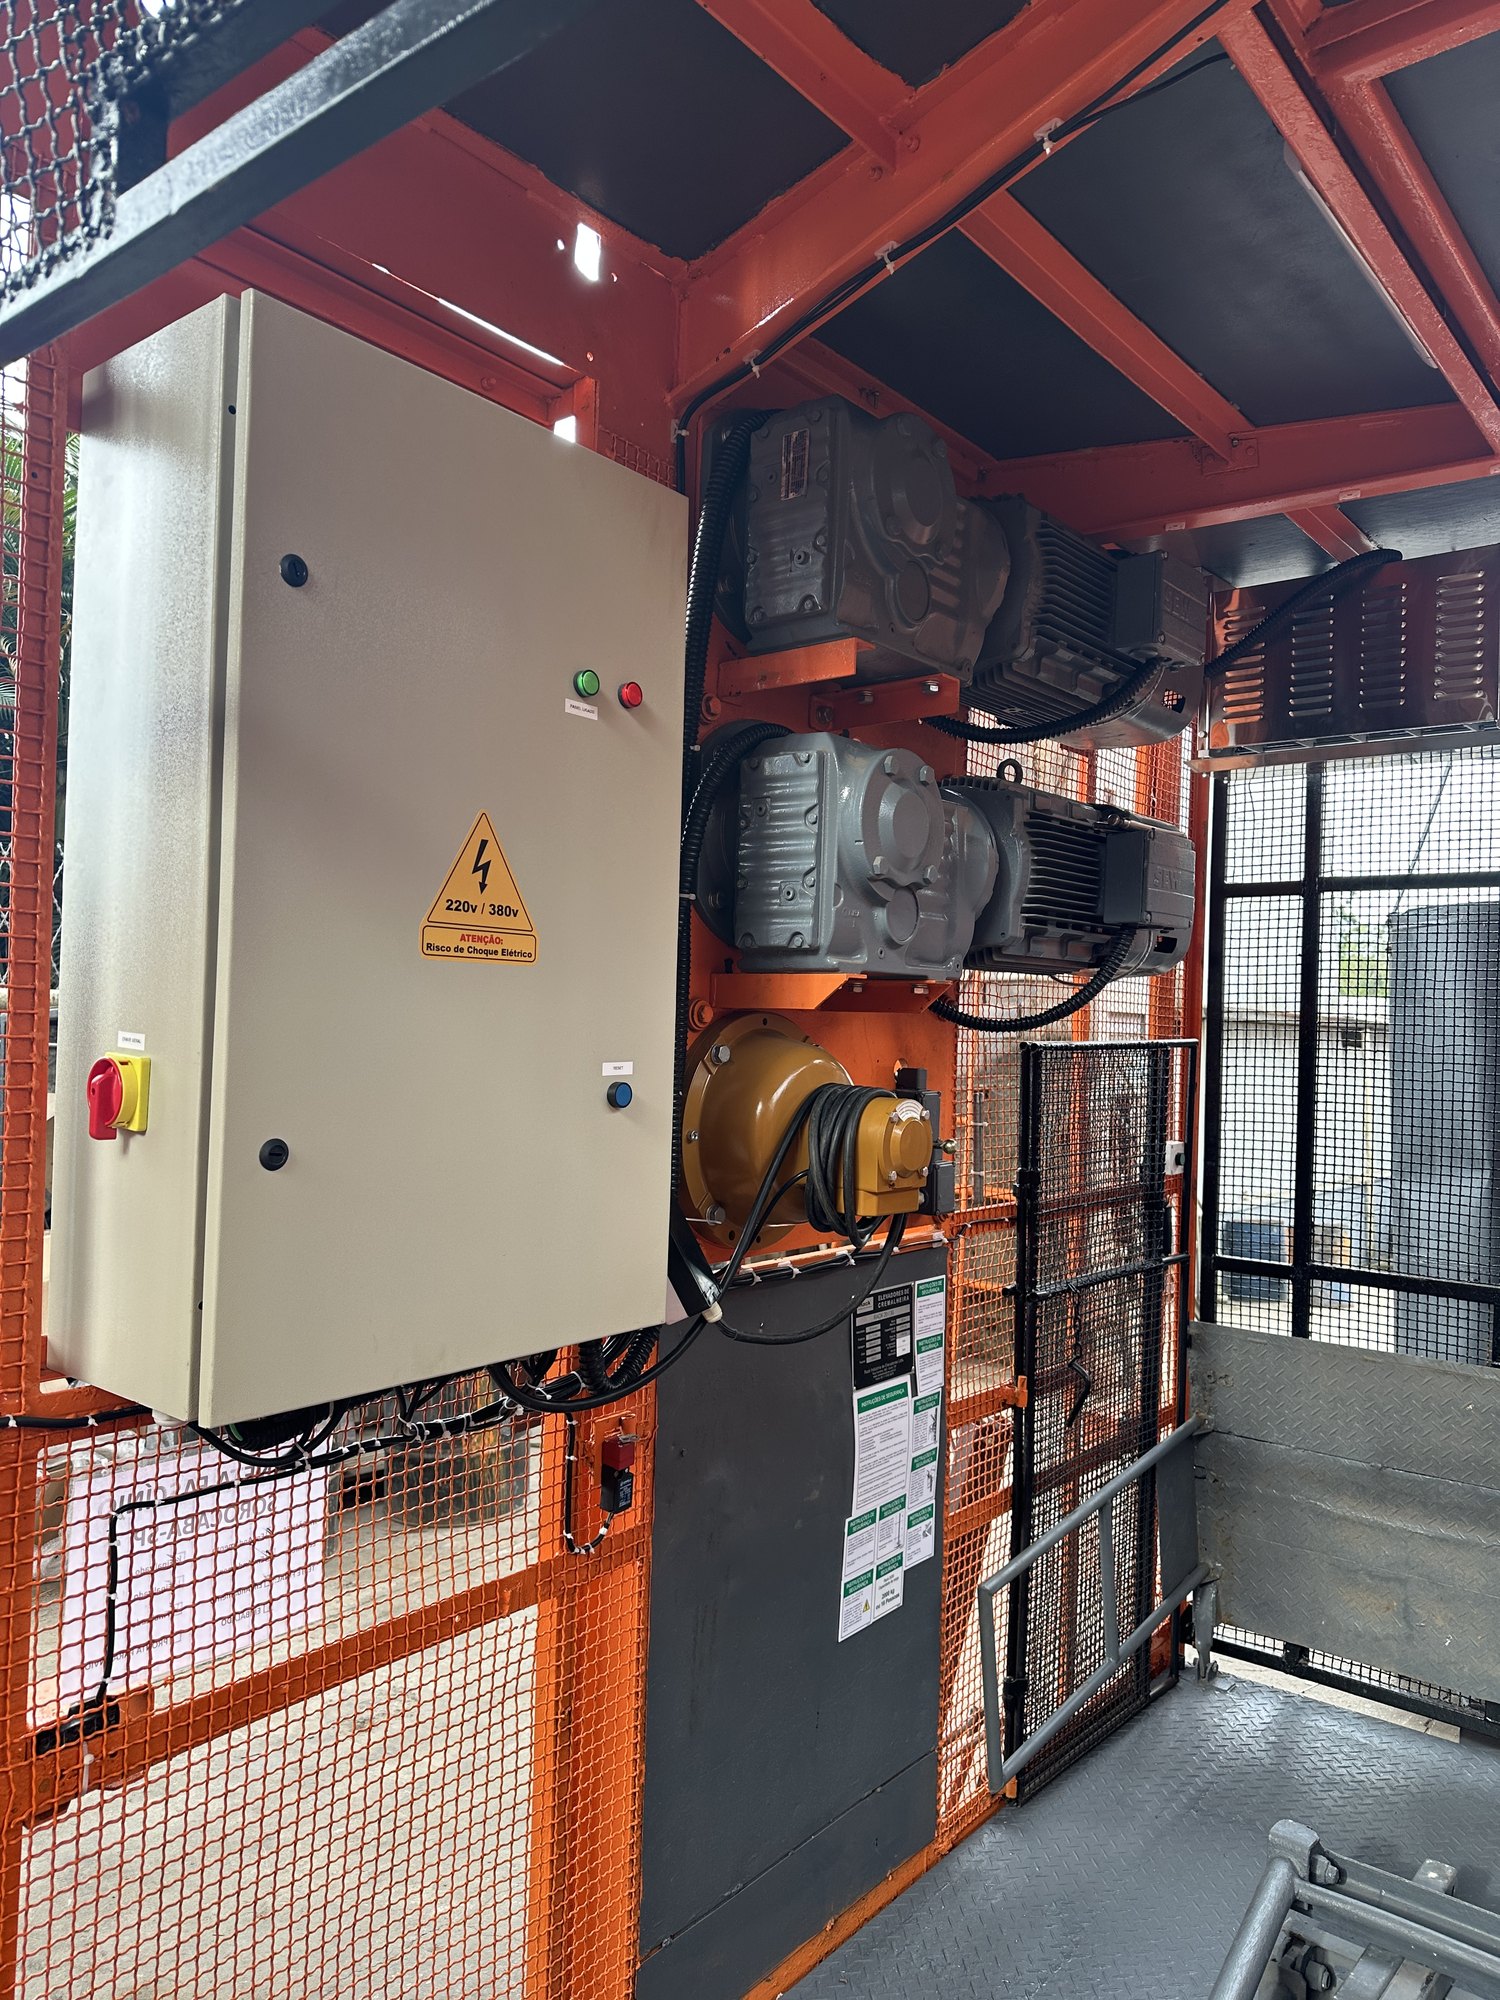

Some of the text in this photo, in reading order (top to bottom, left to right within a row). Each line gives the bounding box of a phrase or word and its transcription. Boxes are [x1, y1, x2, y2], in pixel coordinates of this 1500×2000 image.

[445, 899, 519, 918] 220v / 380v
[460, 934, 504, 946] ATENÇÃO:
[426, 943, 533, 958] Risco de Choque Elétrico
[878, 1289, 903, 1301] ELEVADORES
[878, 1296, 909, 1308] CREMALHEIRA
